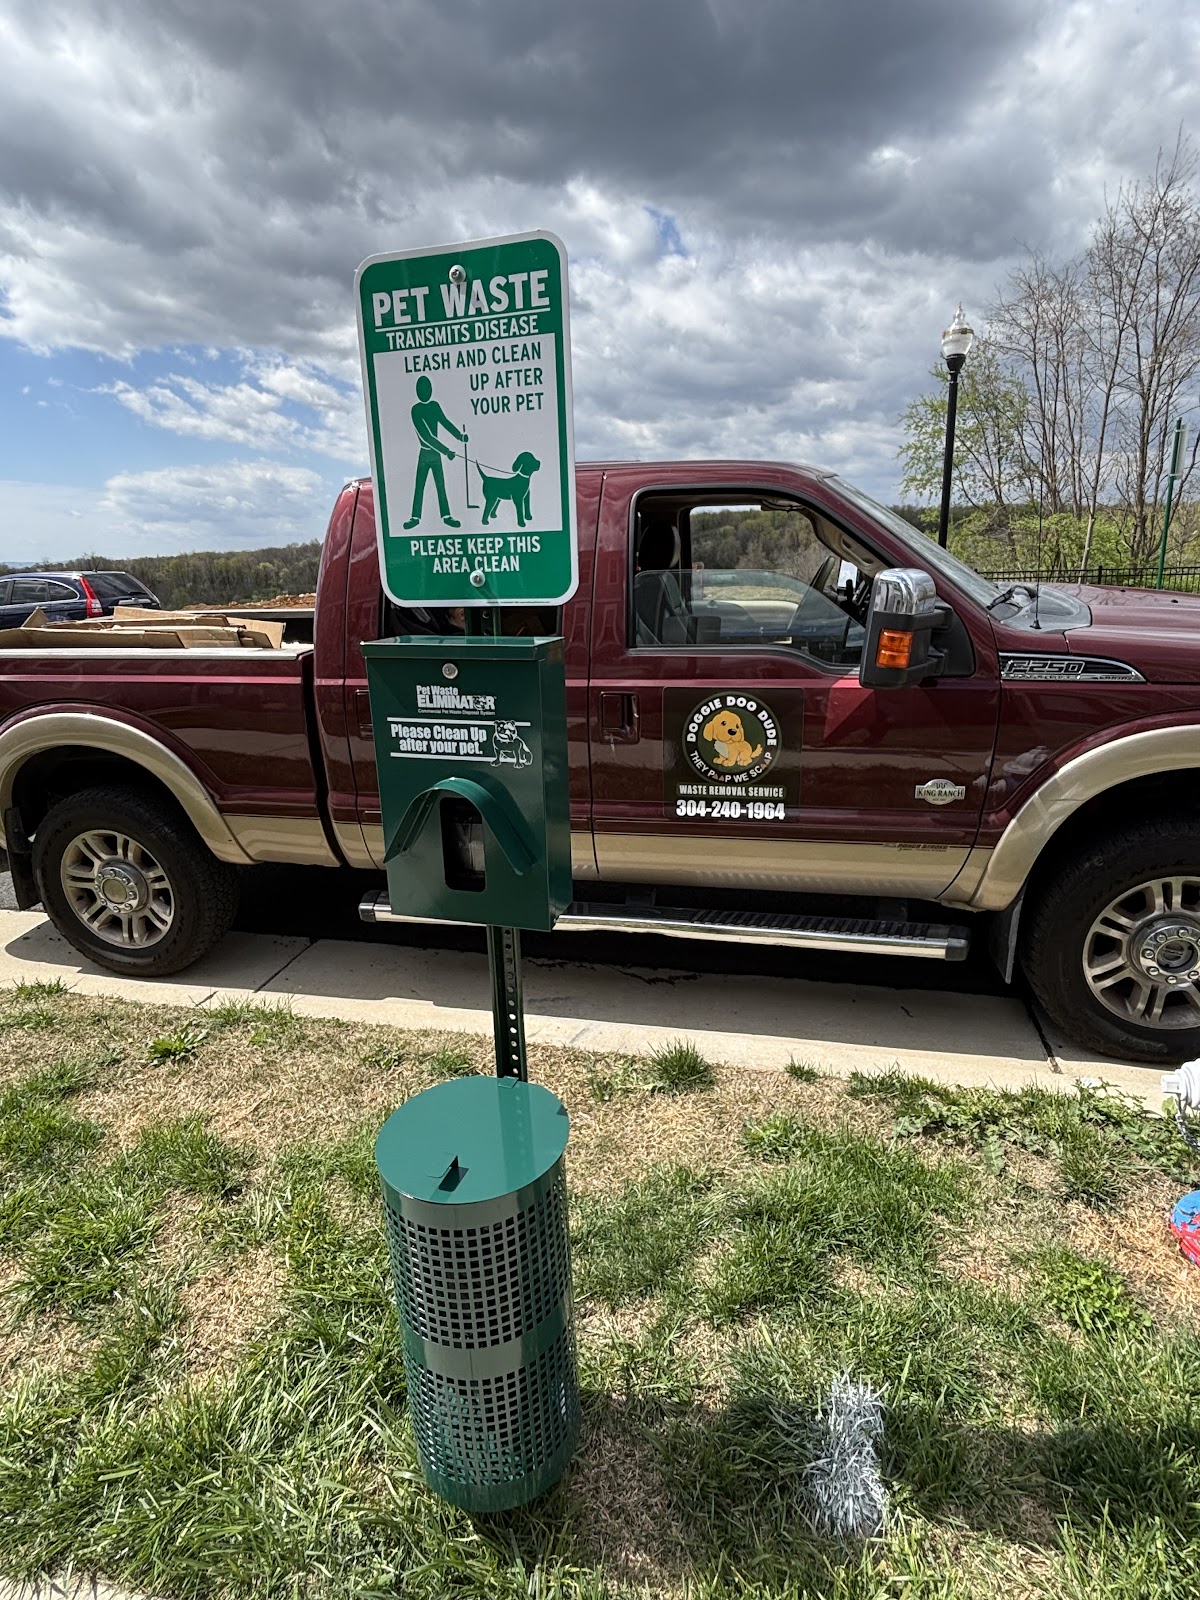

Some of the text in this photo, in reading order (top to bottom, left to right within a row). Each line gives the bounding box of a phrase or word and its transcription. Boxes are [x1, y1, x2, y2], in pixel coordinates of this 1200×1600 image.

[372, 269, 550, 327] PET WASTE
[386, 315, 539, 350] TRANSMITS DISEASE
[404, 342, 541, 374] LEASH AND CLEAN
[470, 367, 543, 391] UP AFTER
[470, 392, 544, 415] YOUR PET
[410, 536, 541, 556] PLEASE KEEP THIS
[433, 556, 520, 574] AREA CLEAN
[416, 685, 458, 696] Pet Waste
[687, 696, 777, 746] DOGGIE DOO DUDE
[391, 724, 487, 742] Please Clean Up
[400, 738, 483, 755] after your pet.
[690, 750, 709, 772] THEY
[733, 773, 749, 783] WE
[679, 785, 783, 797] WASTE REMOVAL SERVICE
[918, 789, 963, 797] KING RANCH
[676, 800, 785, 820] 304-240-1964
